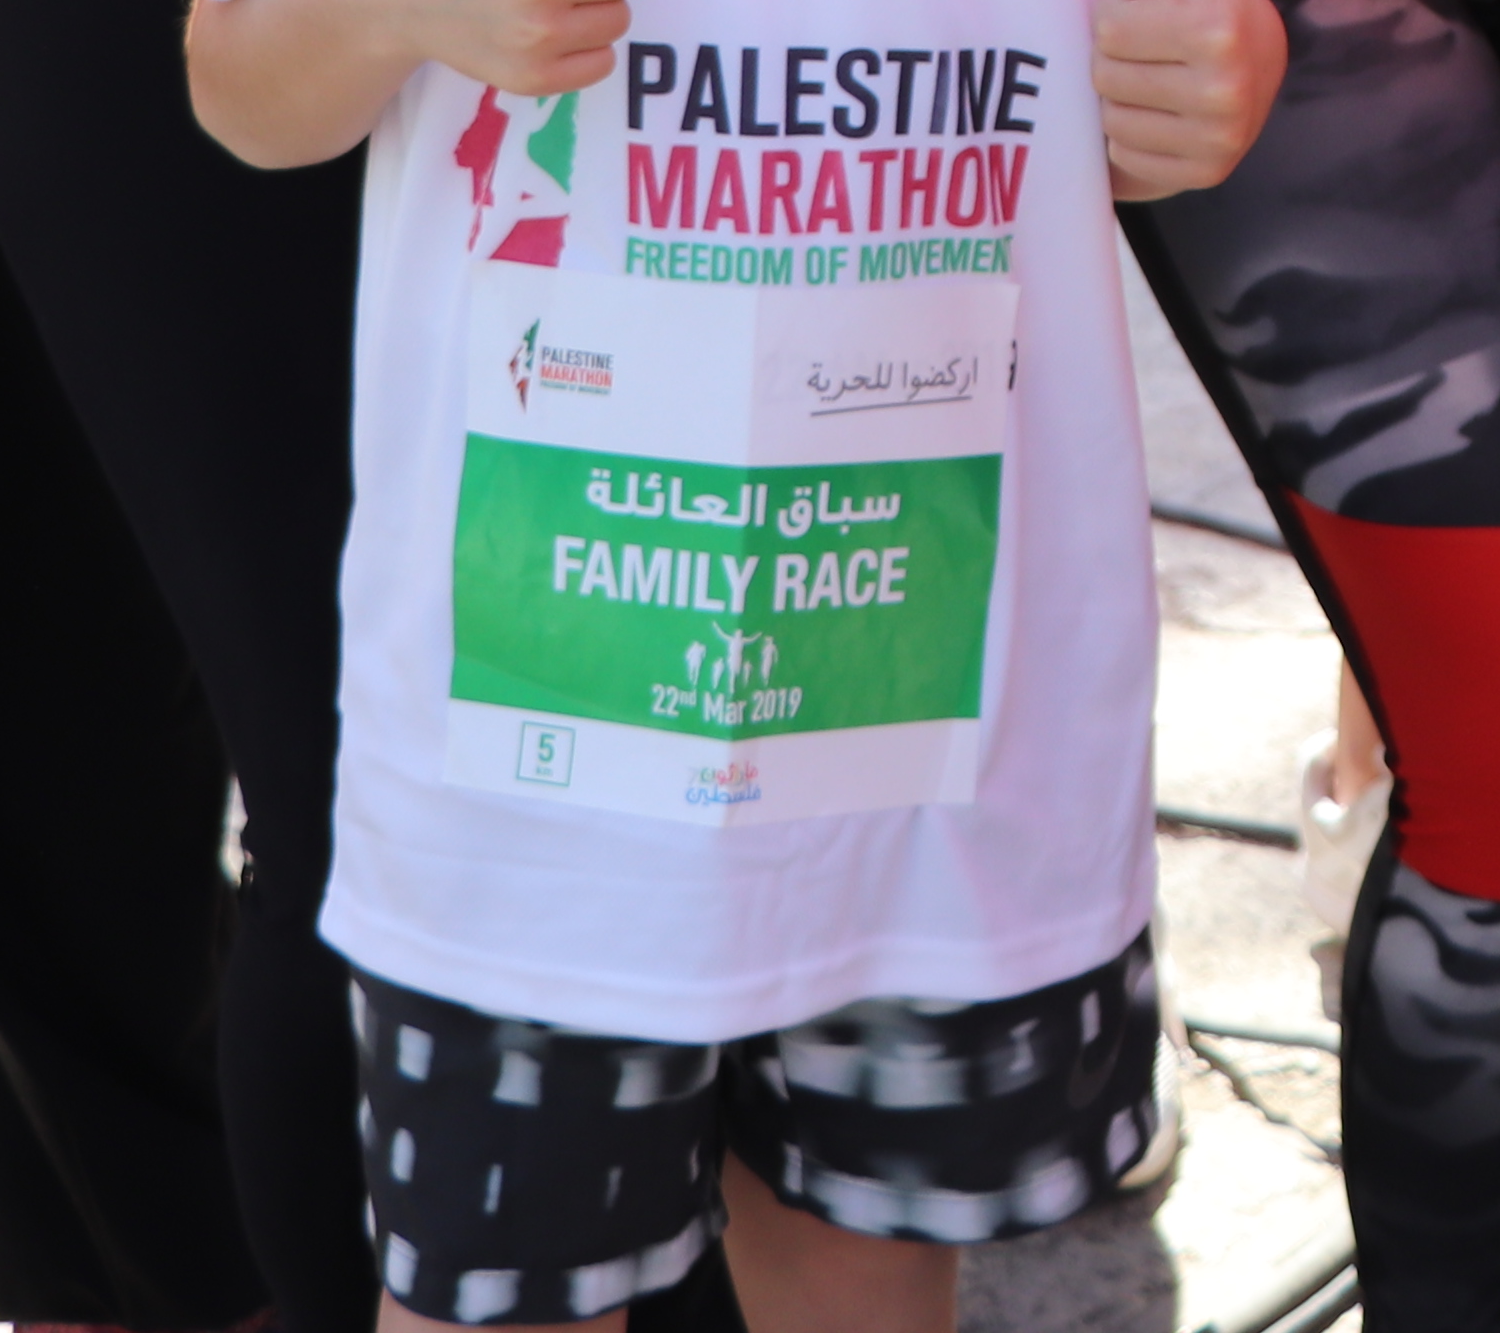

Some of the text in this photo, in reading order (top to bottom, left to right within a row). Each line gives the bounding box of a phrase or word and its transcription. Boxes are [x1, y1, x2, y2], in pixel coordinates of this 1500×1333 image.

[628, 42, 1047, 138] PALESTINE
[628, 142, 1029, 235] MARATHON
[625, 236, 793, 286] FREEDOM
[804, 245, 849, 285] OF
[540, 364, 613, 388] MARATHON
[541, 346, 614, 370] PALESTINE
[806, 361, 893, 402] للحرية
[586, 467, 902, 539] سباق العائلة
[551, 535, 910, 614] FAMILY RACE
[651, 683, 803, 726] 22nd Mar 2019
[538, 732, 556, 763] 5
